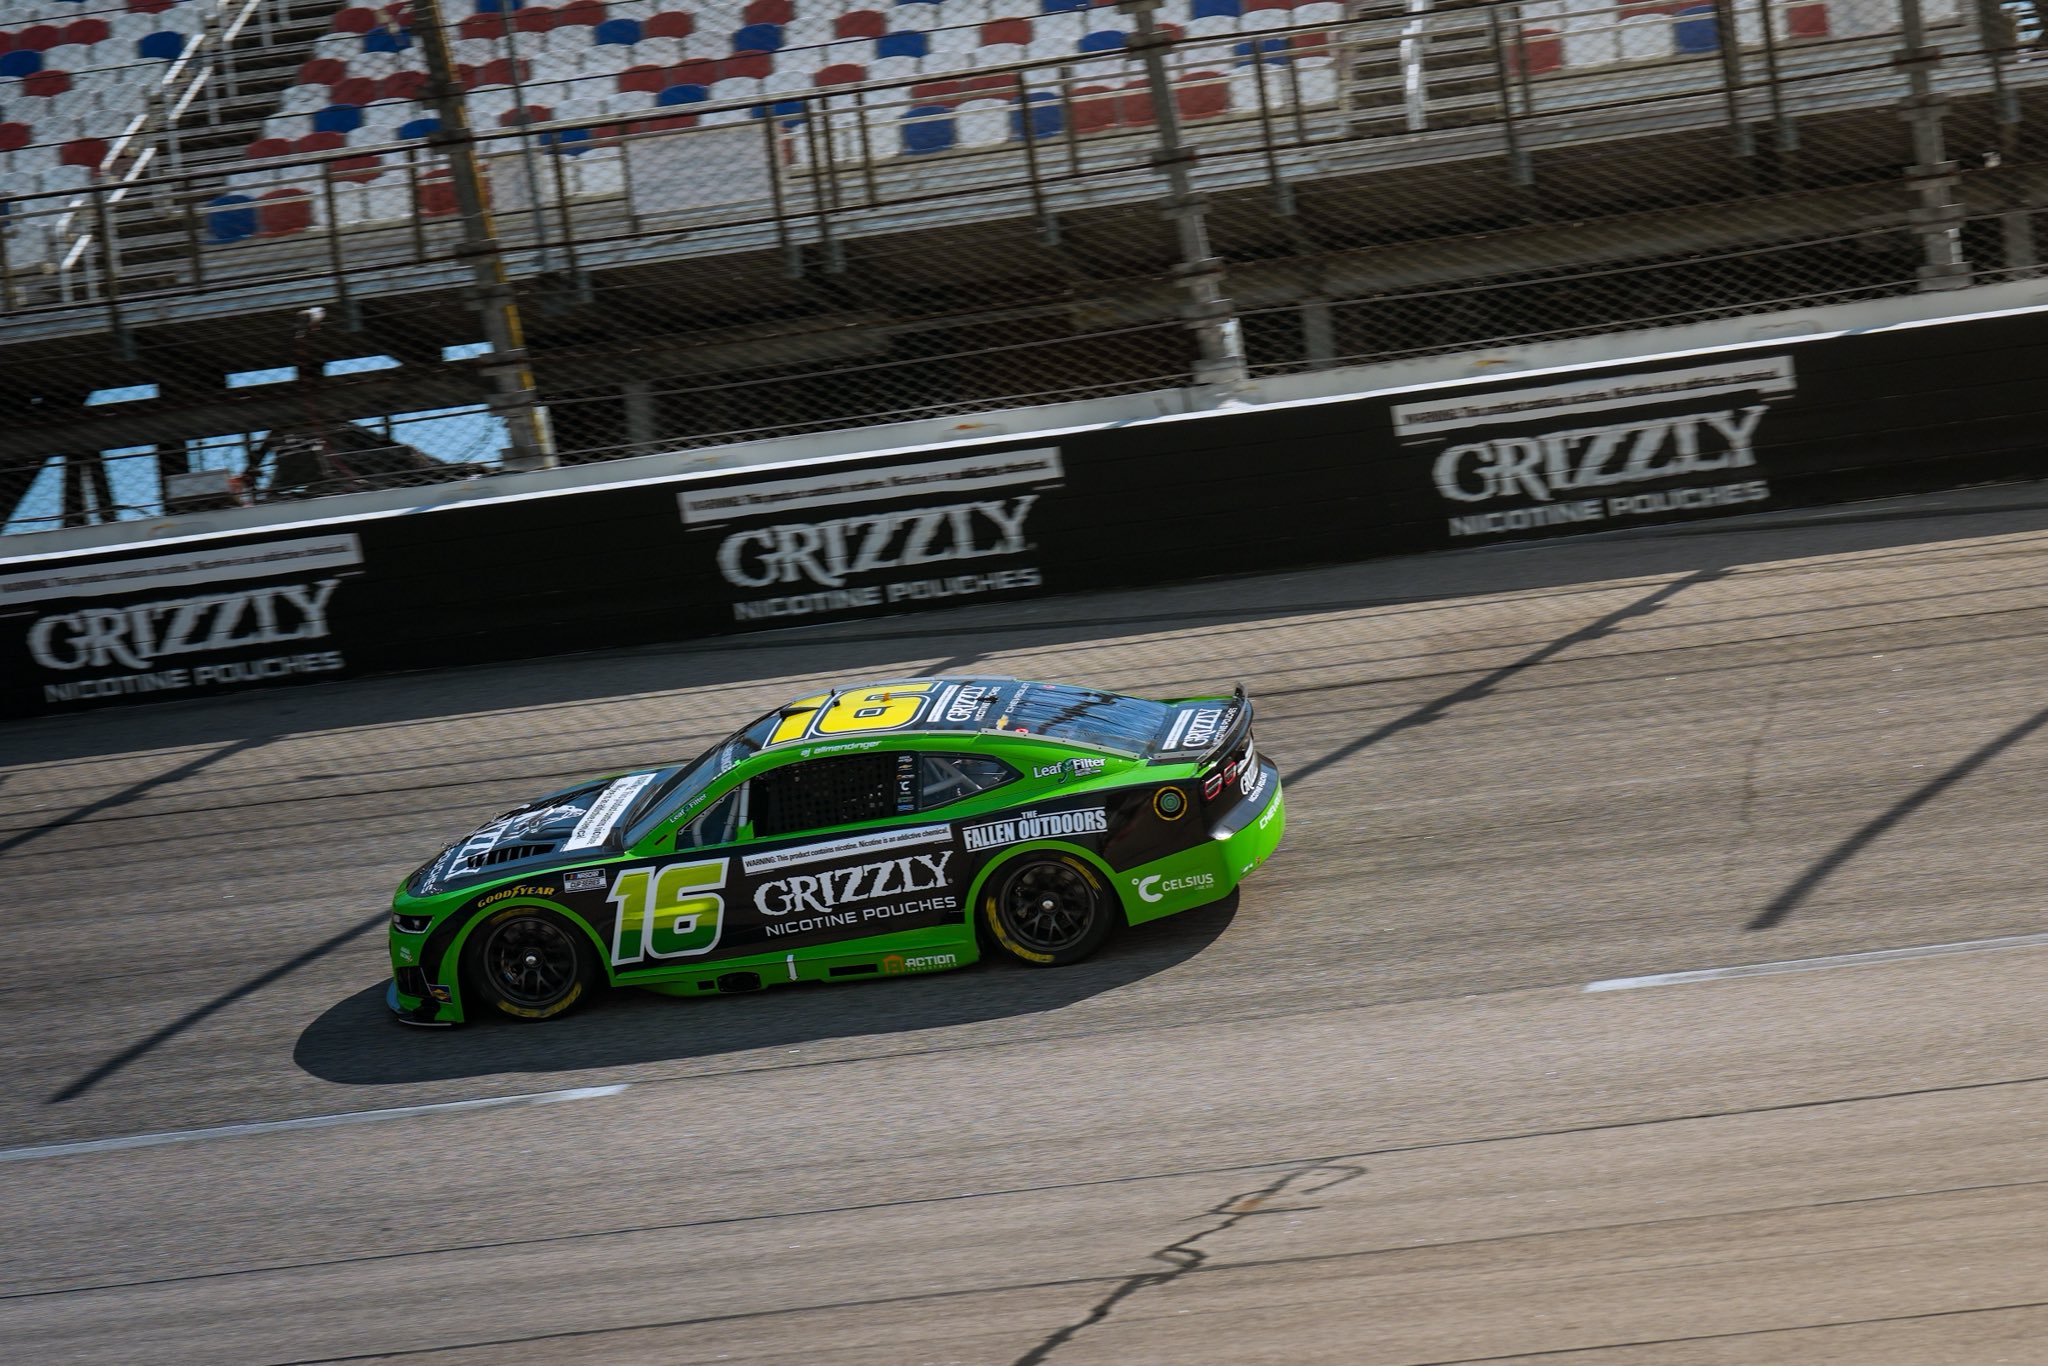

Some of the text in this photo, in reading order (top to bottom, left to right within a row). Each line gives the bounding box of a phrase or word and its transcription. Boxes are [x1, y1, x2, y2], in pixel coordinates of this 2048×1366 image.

[1432, 404, 1770, 502] GRIZZLY
[1449, 479, 1771, 537] NICOTINE POUCHES
[716, 494, 1040, 589] GRIZZLY
[734, 567, 1042, 621] NICOTINE POUCHES
[26, 578, 342, 671] GRIZZLY
[45, 650, 346, 704] NICOTINE POUCHES
[766, 681, 943, 747] 16
[946, 685, 987, 722] GRIZZLY
[813, 740, 882, 755] allmendinger
[1182, 708, 1223, 747] GRIZZLY
[1033, 761, 1063, 778] Leaf
[1072, 758, 1106, 770] Filter
[688, 792, 708, 808] Filter
[1021, 810, 1038, 819] THE
[745, 856, 776, 868] WARNING:
[776, 854, 789, 862] This
[789, 850, 811, 861] product
[811, 846, 834, 856] contains
[858, 838, 882, 848] Nicotine
[896, 831, 922, 842] addictive
[921, 826, 949, 837] chemical.
[963, 810, 1108, 850] FALLEN OUTDOORS
[477, 884, 555, 908] GOODYEAR
[753, 850, 954, 917] GRIZZLY
[1162, 873, 1214, 892] CELSIUS
[605, 857, 731, 967] 16
[765, 896, 957, 937] NICOTINE POUCHES
[905, 953, 956, 968] ACTION
